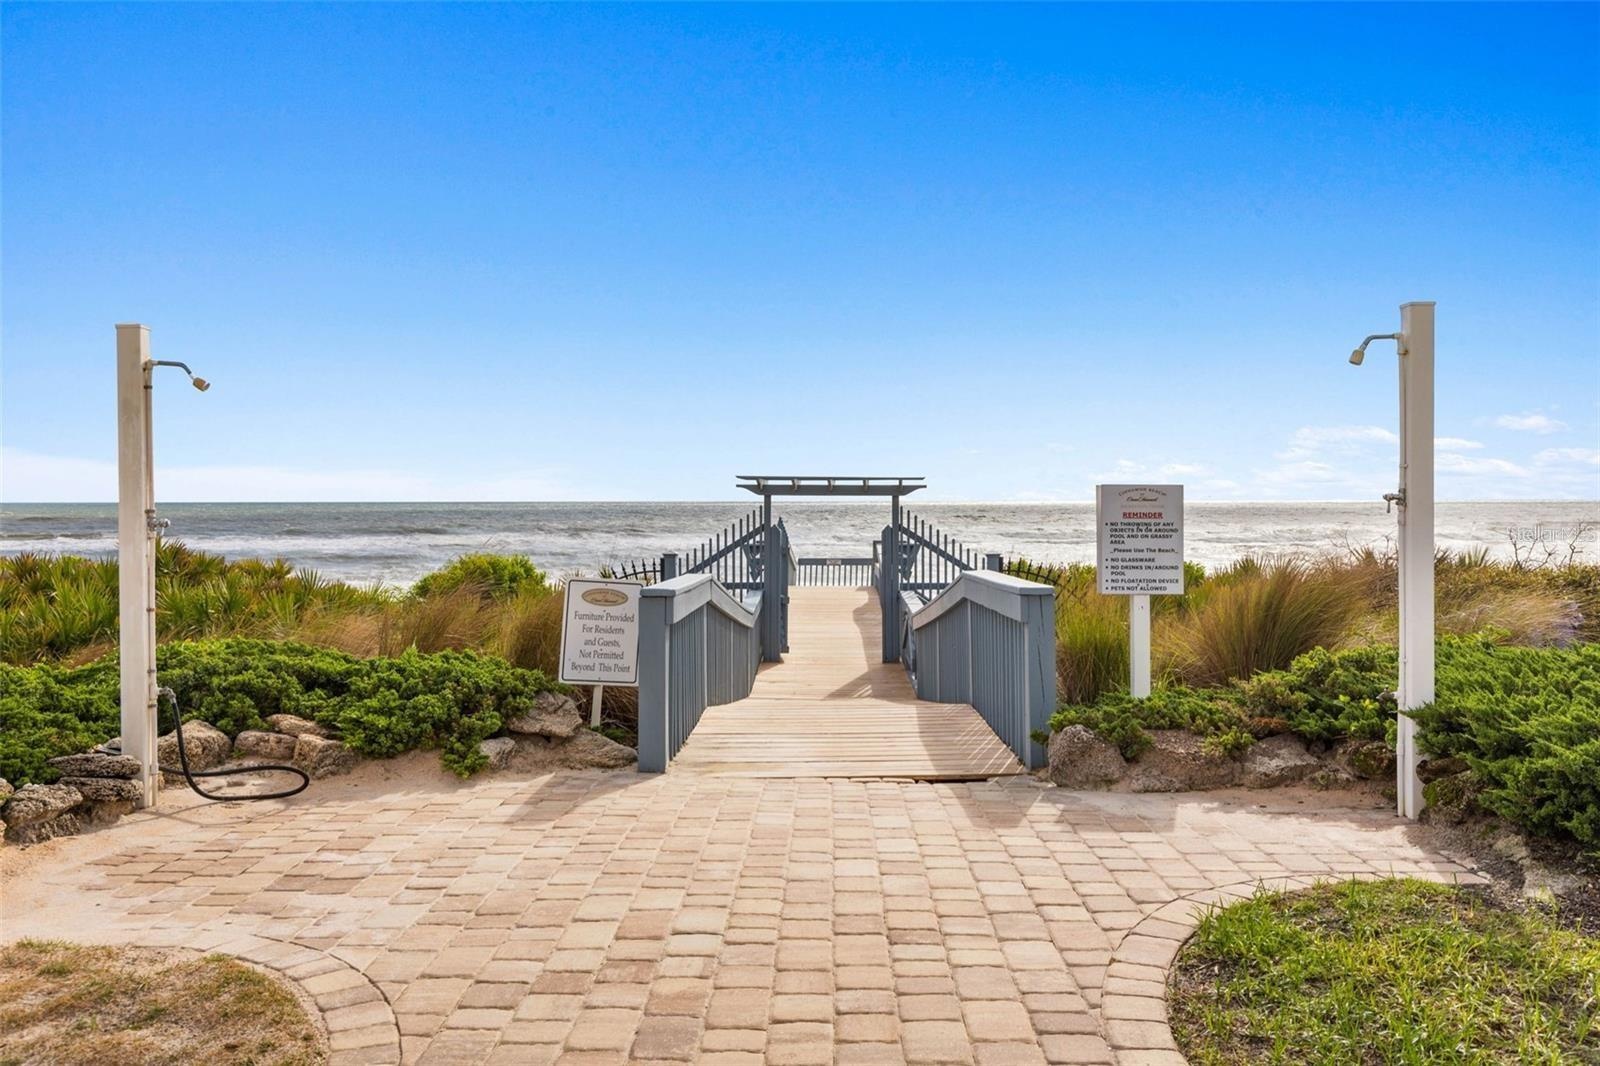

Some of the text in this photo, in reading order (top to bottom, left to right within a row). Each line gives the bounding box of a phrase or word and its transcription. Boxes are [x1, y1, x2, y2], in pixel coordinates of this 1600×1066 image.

[574, 611, 634, 622] Furniture Provided
[582, 624, 624, 634] For Residents
[584, 638, 596, 646] and
[579, 649, 624, 659] Not Permitted
[571, 663, 630, 673] Beyond This Point
